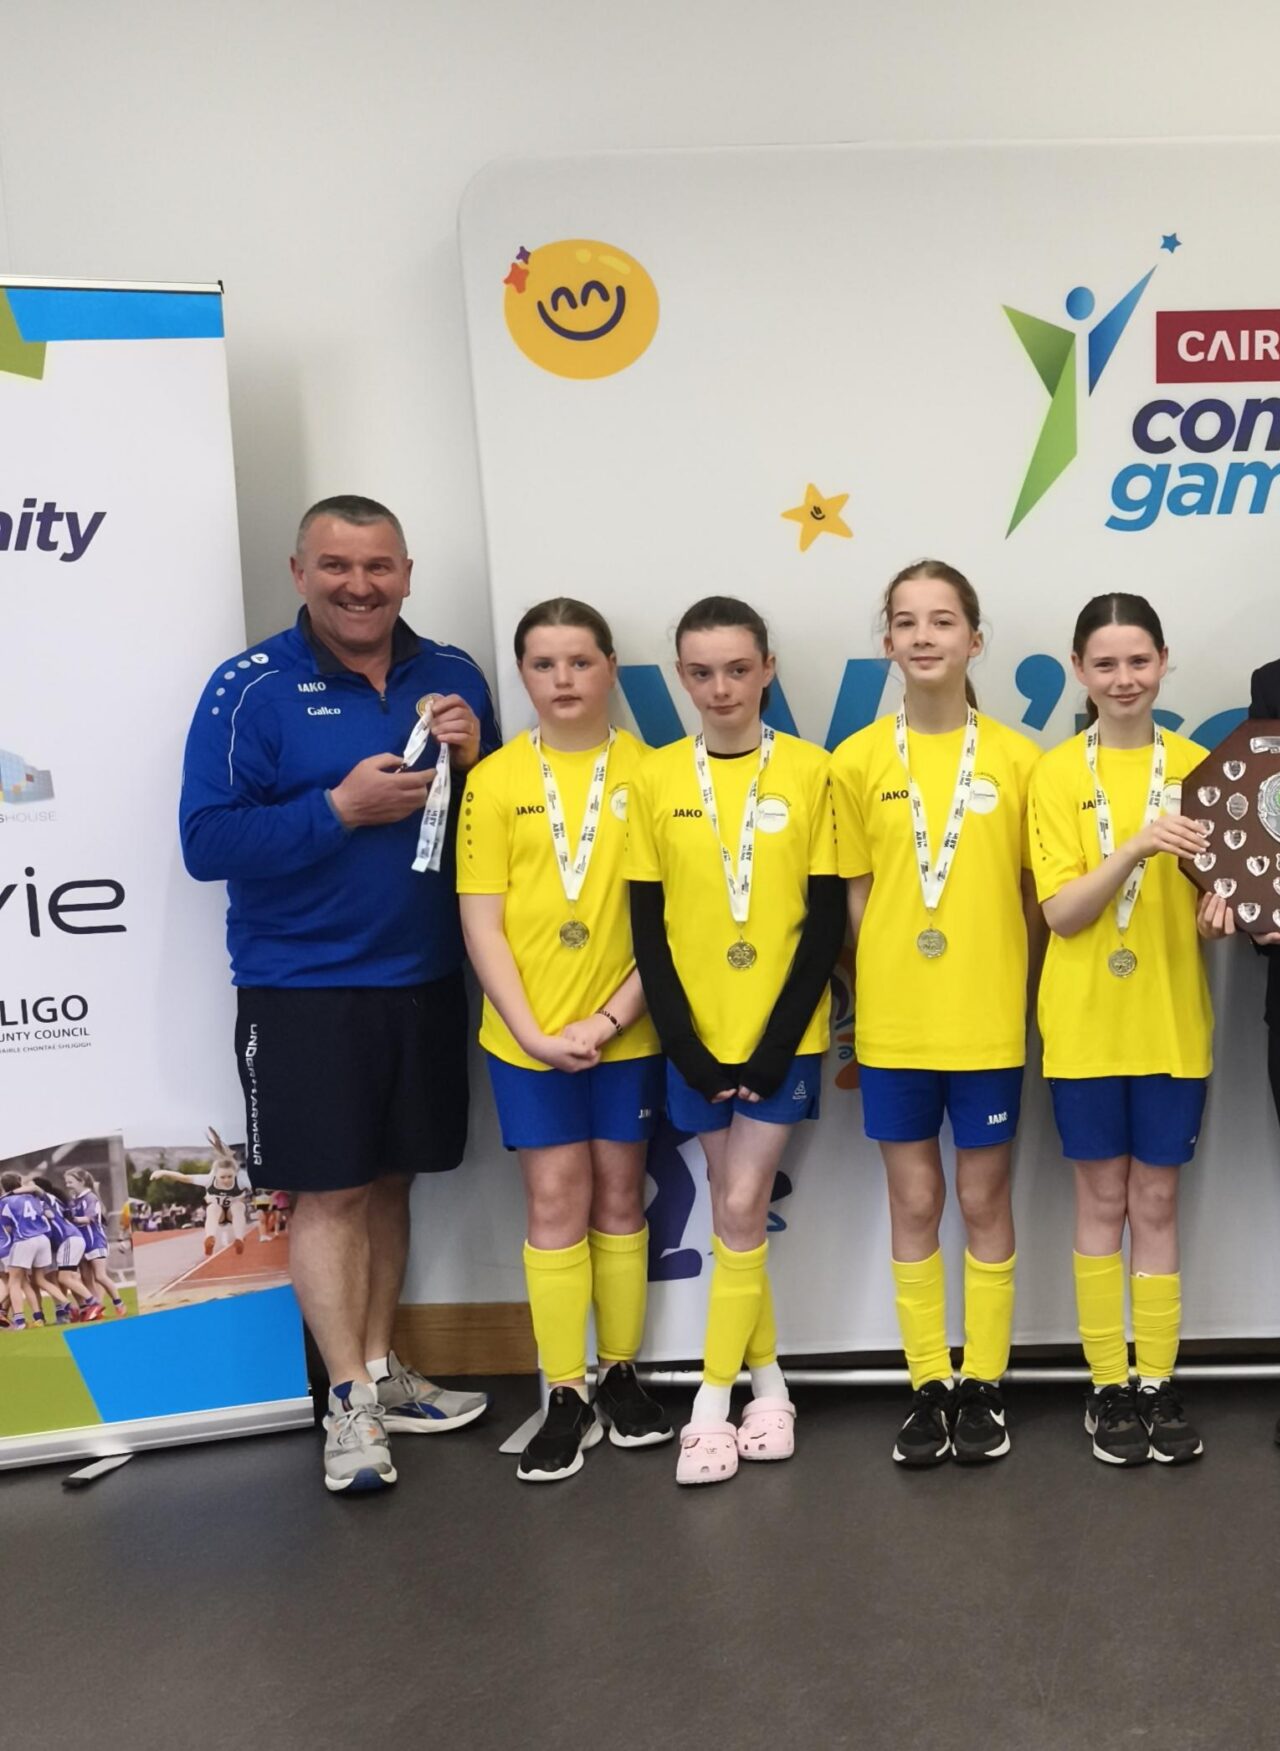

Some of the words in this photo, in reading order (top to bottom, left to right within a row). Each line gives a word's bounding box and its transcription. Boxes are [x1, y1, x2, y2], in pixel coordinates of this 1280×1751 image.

[881, 790, 909, 801] JAKO
[672, 808, 703, 818] JAKO
[34, 1027, 91, 1040] COUNCIL
